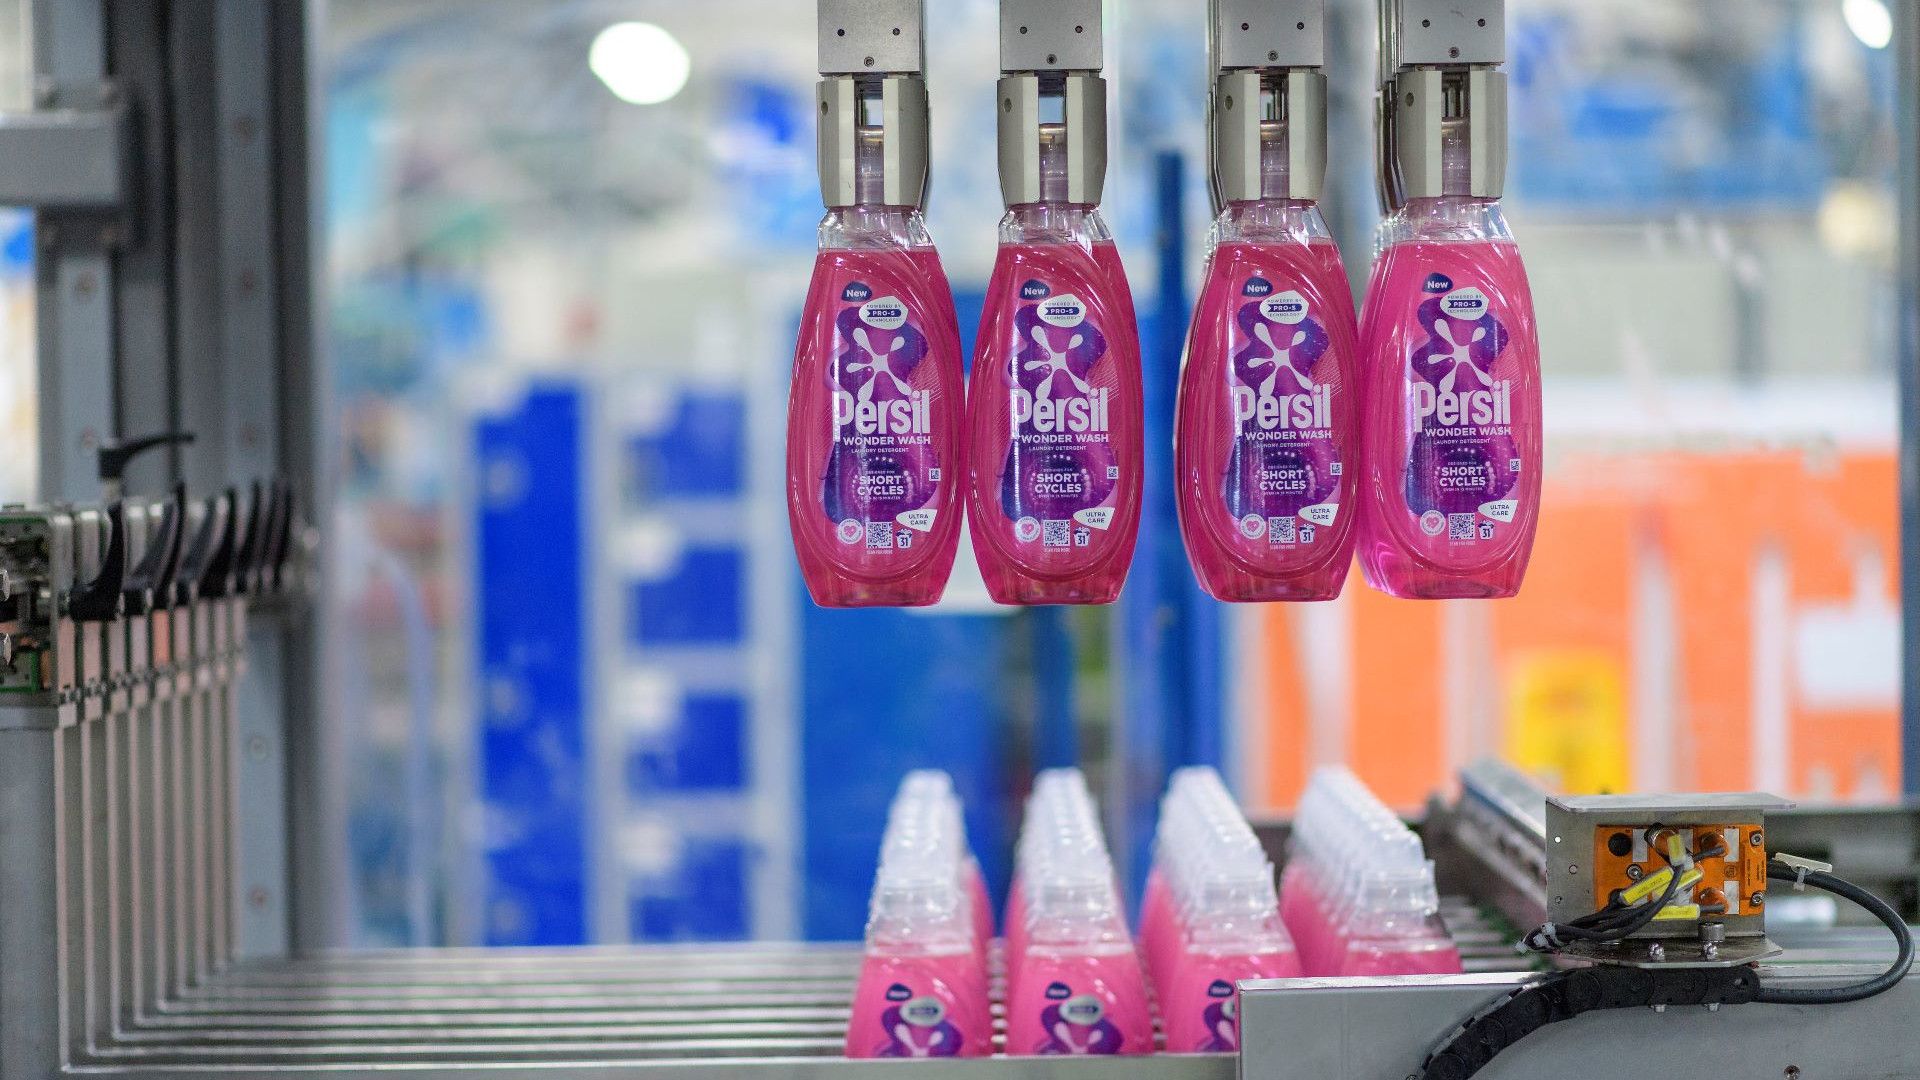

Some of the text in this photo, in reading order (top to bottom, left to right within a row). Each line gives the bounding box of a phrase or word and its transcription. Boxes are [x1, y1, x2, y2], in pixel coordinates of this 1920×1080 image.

[846, 290, 868, 298] New
[1233, 384, 1332, 436] Persil
[1413, 380, 1510, 432] Persil
[832, 390, 931, 441] Persil
[1010, 387, 1108, 439] Persil
[1244, 430, 1332, 440] WONDER WASH
[1425, 427, 1511, 436] WONDER WASH
[843, 436, 931, 446] WONDER WASH
[1021, 434, 1108, 444] WONDER WASH
[1262, 470, 1302, 480] SHORT
[1442, 467, 1482, 476] SHORT
[860, 476, 901, 485] SHORT
[1037, 474, 1078, 482] SHORT
[1440, 477, 1486, 486] CYCLES
[1034, 484, 1081, 493] CYCLES
[1260, 481, 1306, 490] CYCLES
[858, 486, 904, 495] CYCLES
[1303, 532, 1310, 540] 31
[1482, 528, 1490, 538] 31
[900, 538, 908, 546] 31
[1078, 536, 1086, 544] 31
